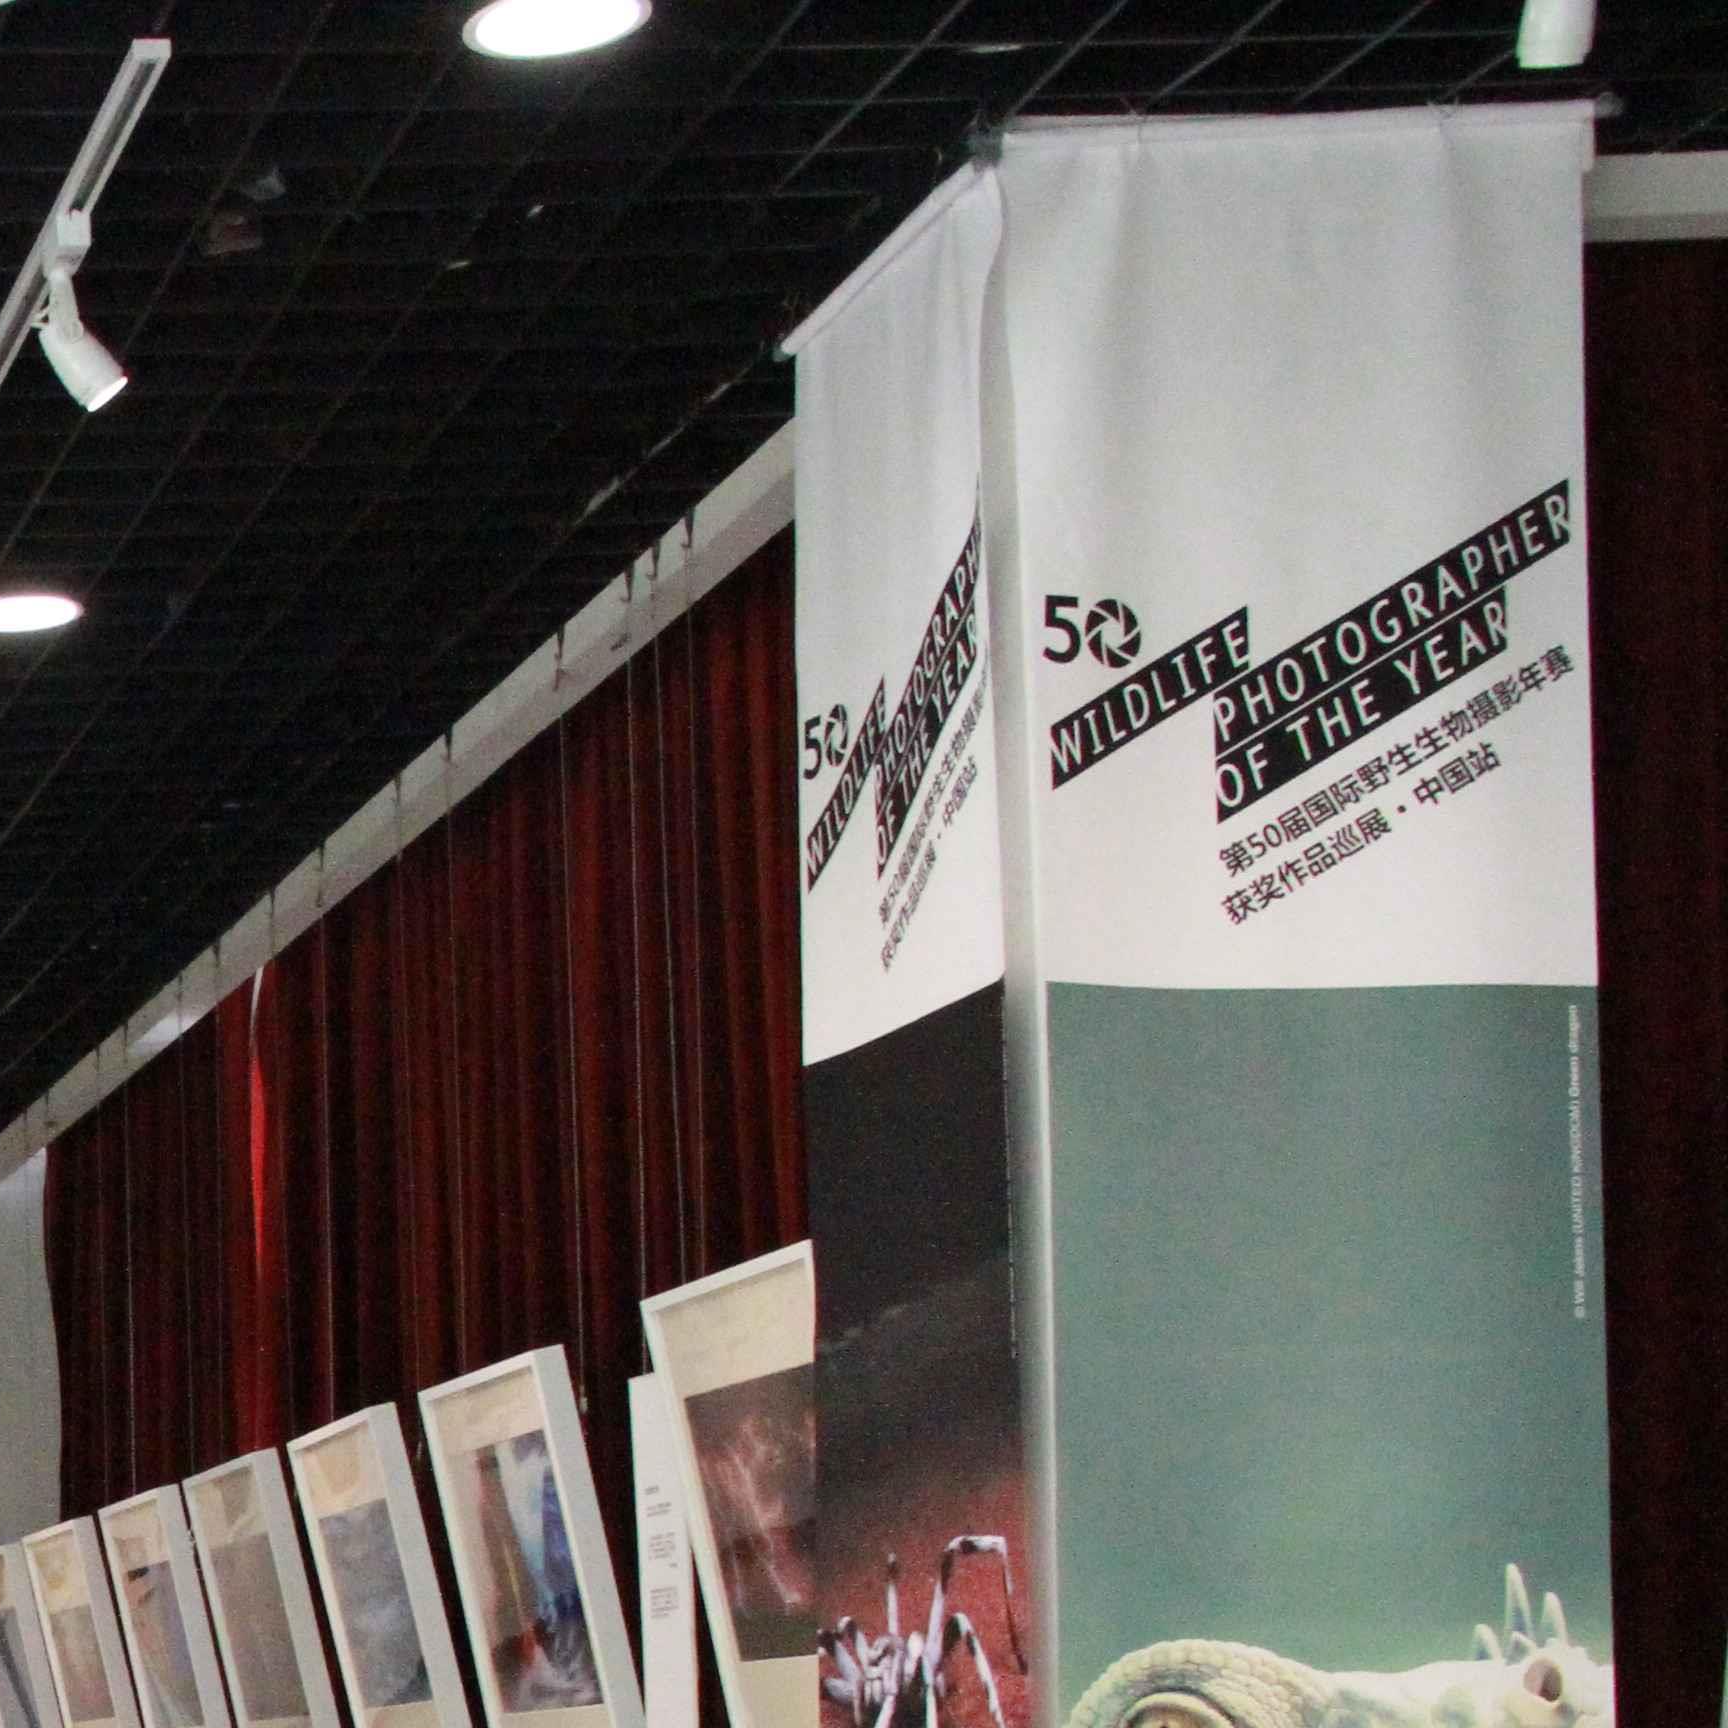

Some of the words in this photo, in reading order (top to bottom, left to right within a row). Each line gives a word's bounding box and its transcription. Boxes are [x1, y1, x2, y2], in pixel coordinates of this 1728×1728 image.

[1050, 619, 1249, 774] WILDLIFE
[1214, 494, 1569, 742] PHOTOGRAPHER
[1217, 743, 1268, 807] OF
[1286, 679, 1381, 762] THE
[1394, 601, 1506, 696] YEAR
[807, 689, 886, 875] WILDLIFE
[877, 801, 895, 866] OF
[899, 718, 931, 804] THE
[932, 613, 976, 723] YEAR
[1218, 644, 1575, 878] 第50届国际野生生物摄影年赛
